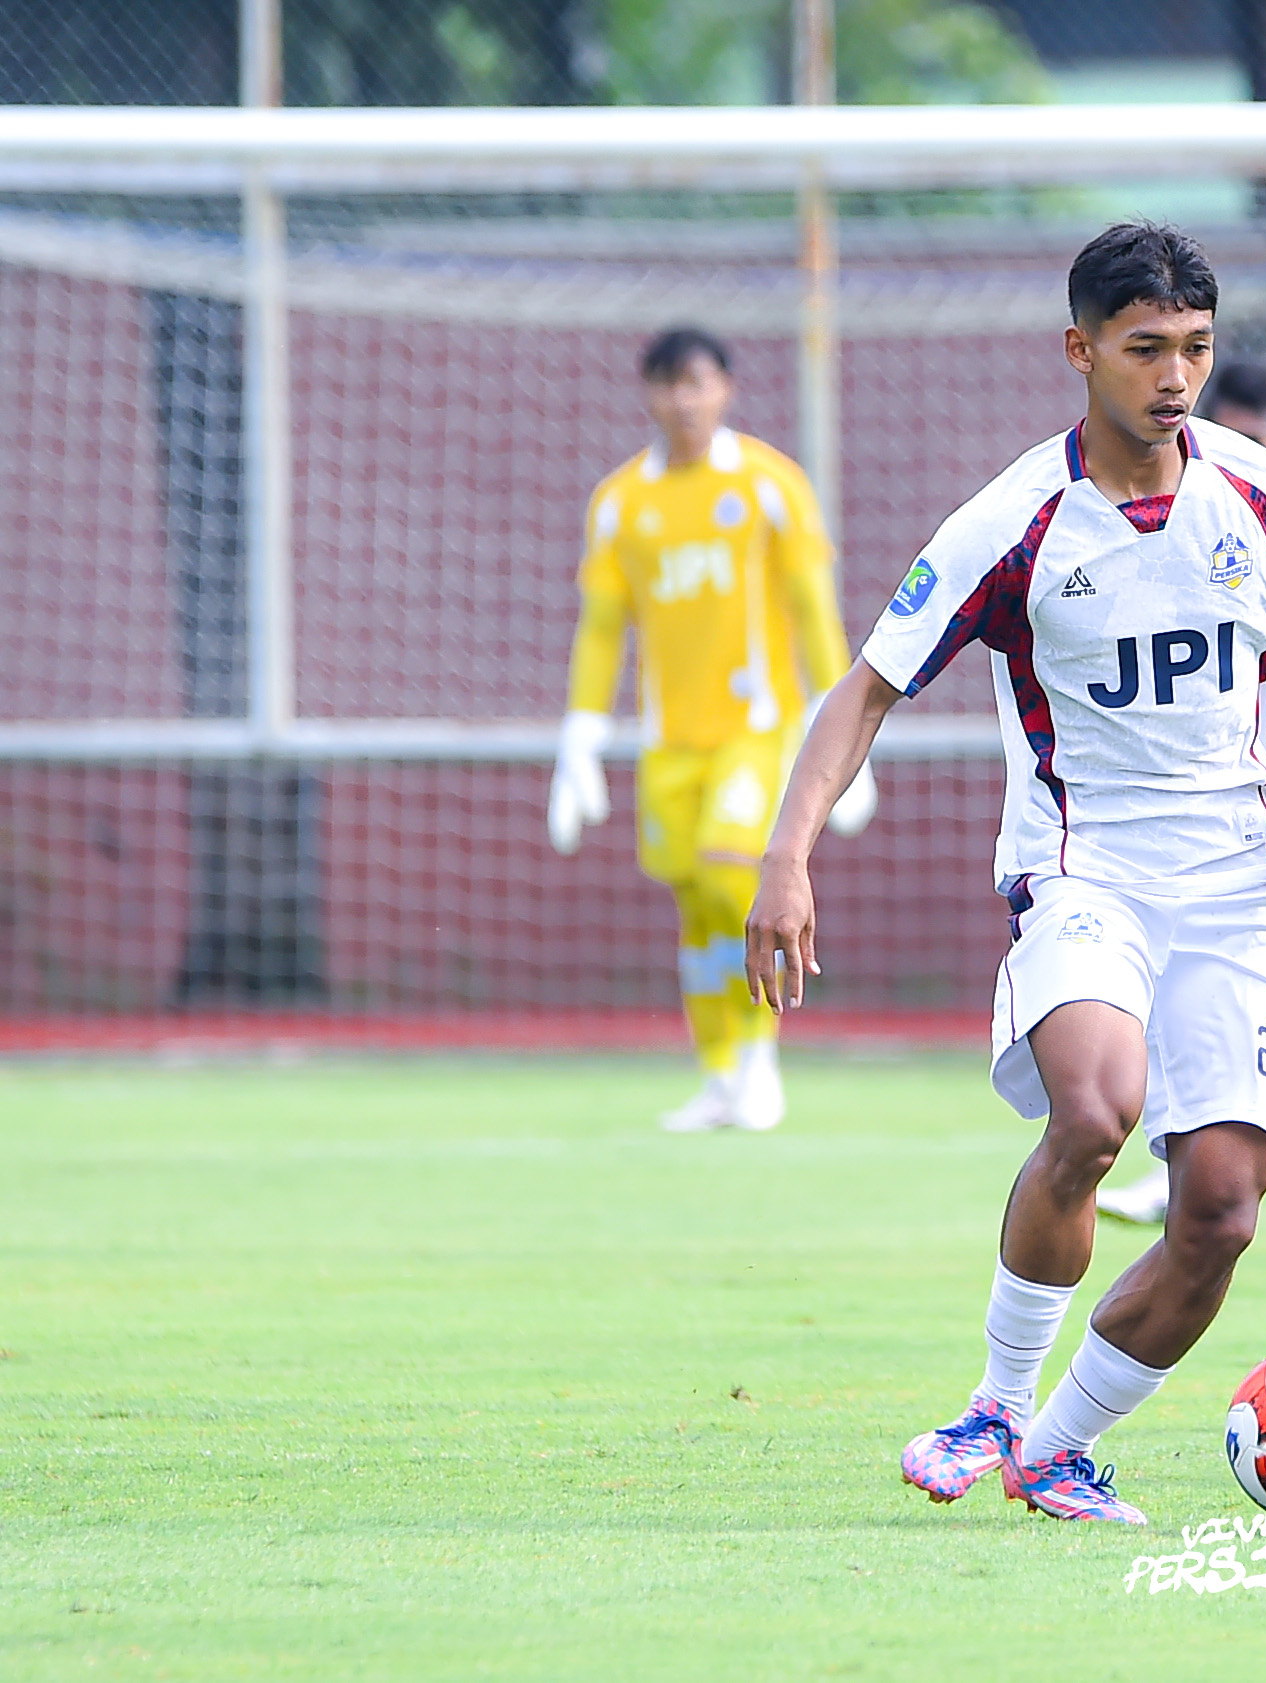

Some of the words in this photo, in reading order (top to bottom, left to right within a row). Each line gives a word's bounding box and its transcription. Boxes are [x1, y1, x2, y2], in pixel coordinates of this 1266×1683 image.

[650, 540, 735, 604] JPI
[1061, 587, 1097, 598] amrta
[1087, 621, 1236, 709] JPI
